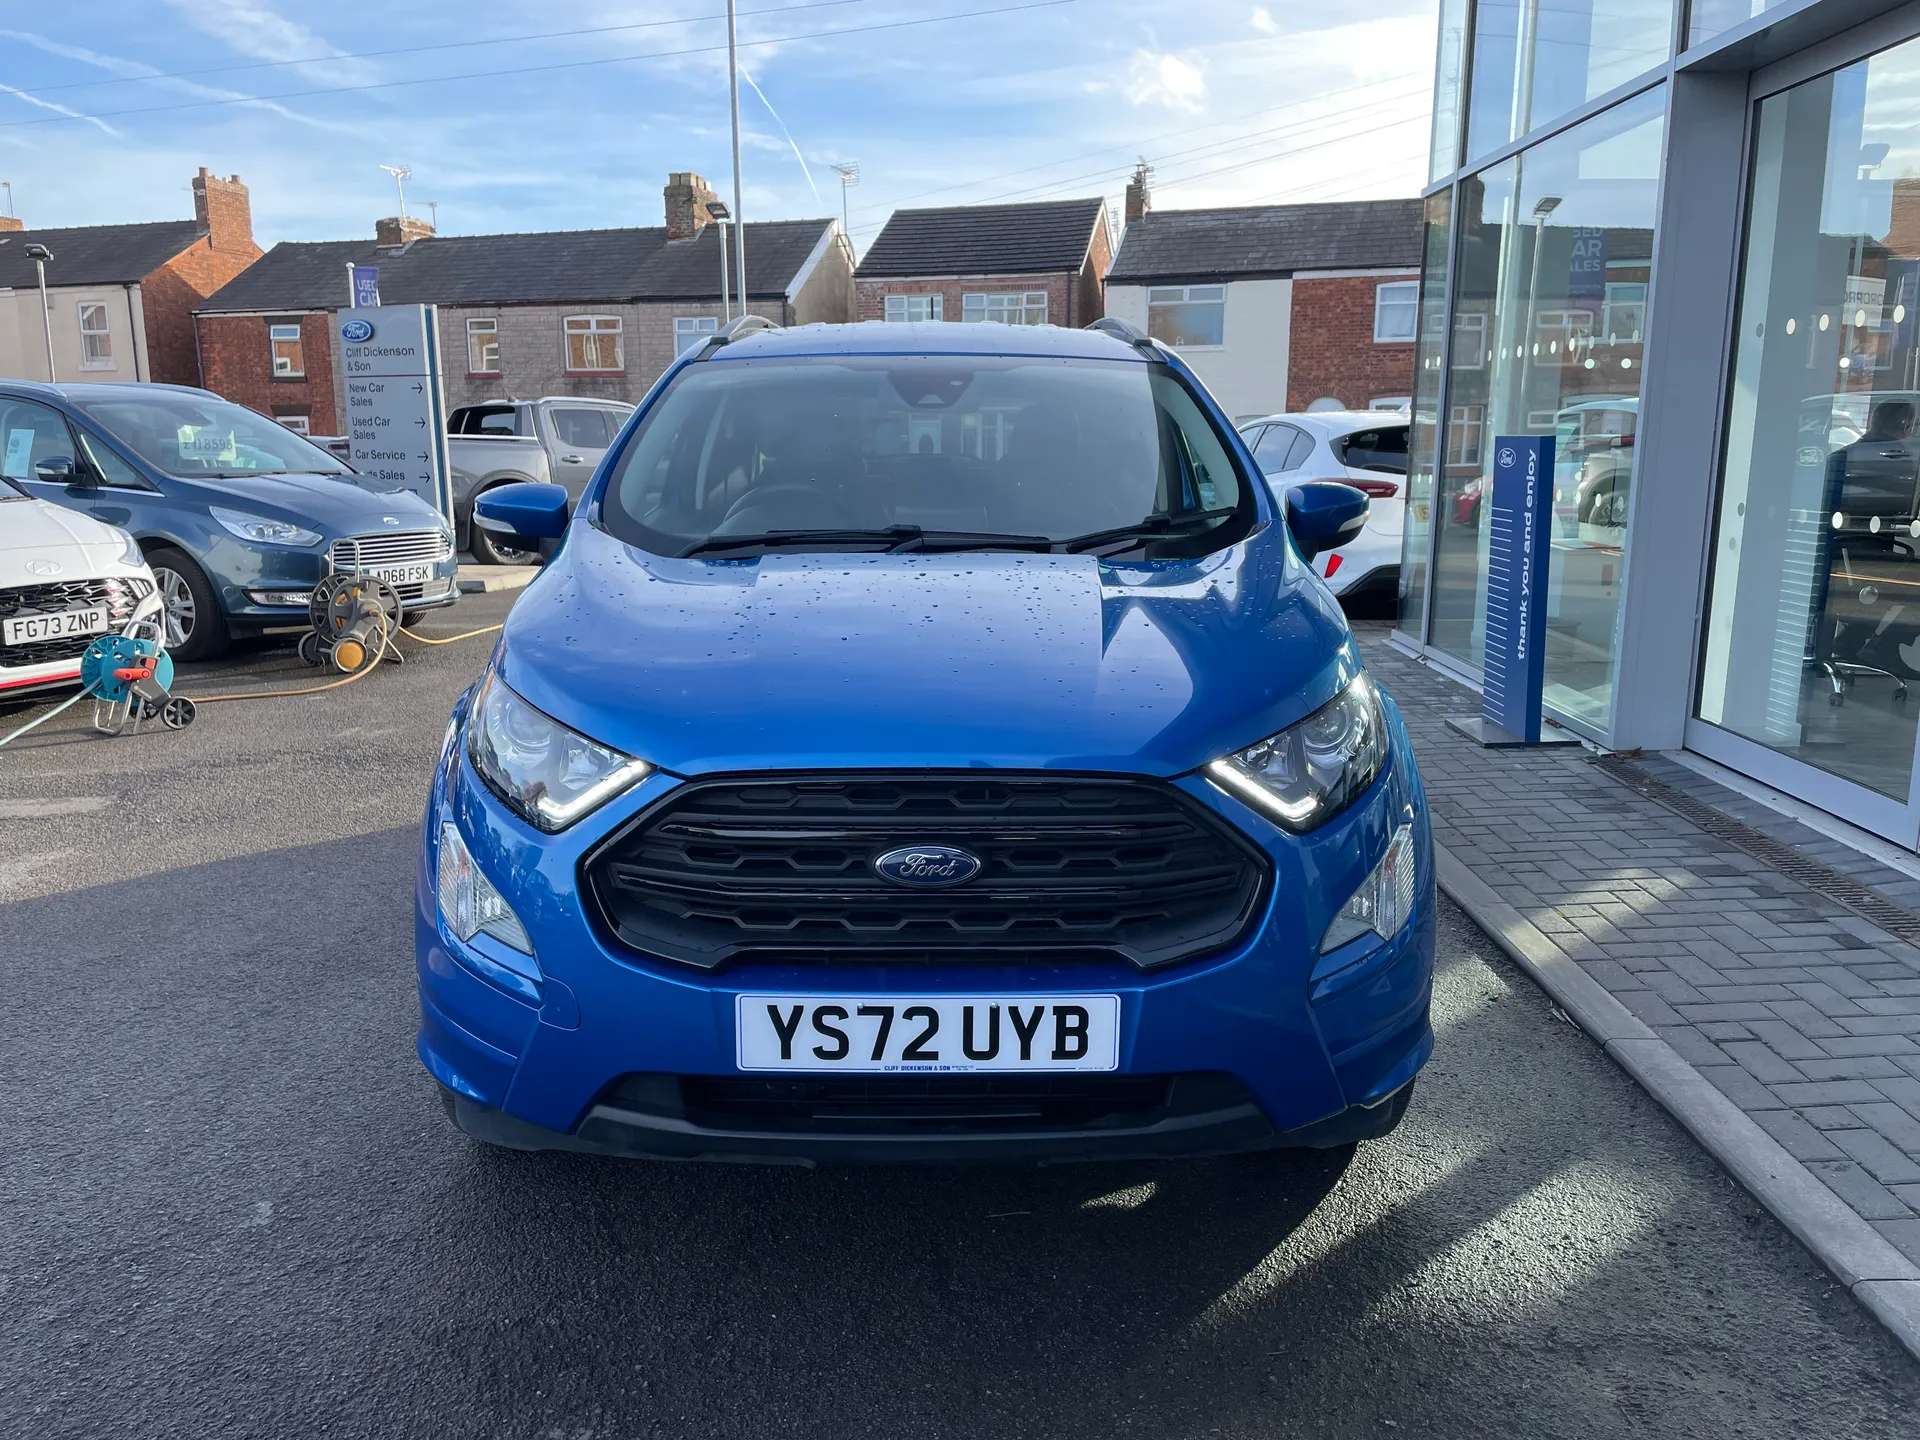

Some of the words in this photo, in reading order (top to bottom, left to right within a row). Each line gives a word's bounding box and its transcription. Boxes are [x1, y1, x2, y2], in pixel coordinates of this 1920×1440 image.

[363, 346, 415, 357] Dickenson
[354, 360, 372, 371] Son
[349, 383, 367, 393] New
[368, 382, 385, 393] Car
[350, 396, 373, 407] Sales
[352, 416, 373, 427] Used
[374, 416, 391, 427] Car
[353, 429, 376, 440] Sales
[355, 449, 369, 460] Car
[370, 449, 406, 460] Service
[379, 469, 406, 481] Sales
[1526, 449, 1537, 509] enjoy
[1523, 512, 1532, 553] and
[408, 566, 429, 581] FSK
[1521, 558, 1531, 597] you
[13, 617, 62, 640] FG73
[66, 612, 99, 632] ZNP
[1517, 599, 1528, 660] thank
[900, 853, 956, 877] Ford
[767, 1004, 940, 1061] YS72
[962, 1005, 1090, 1061] UYB
